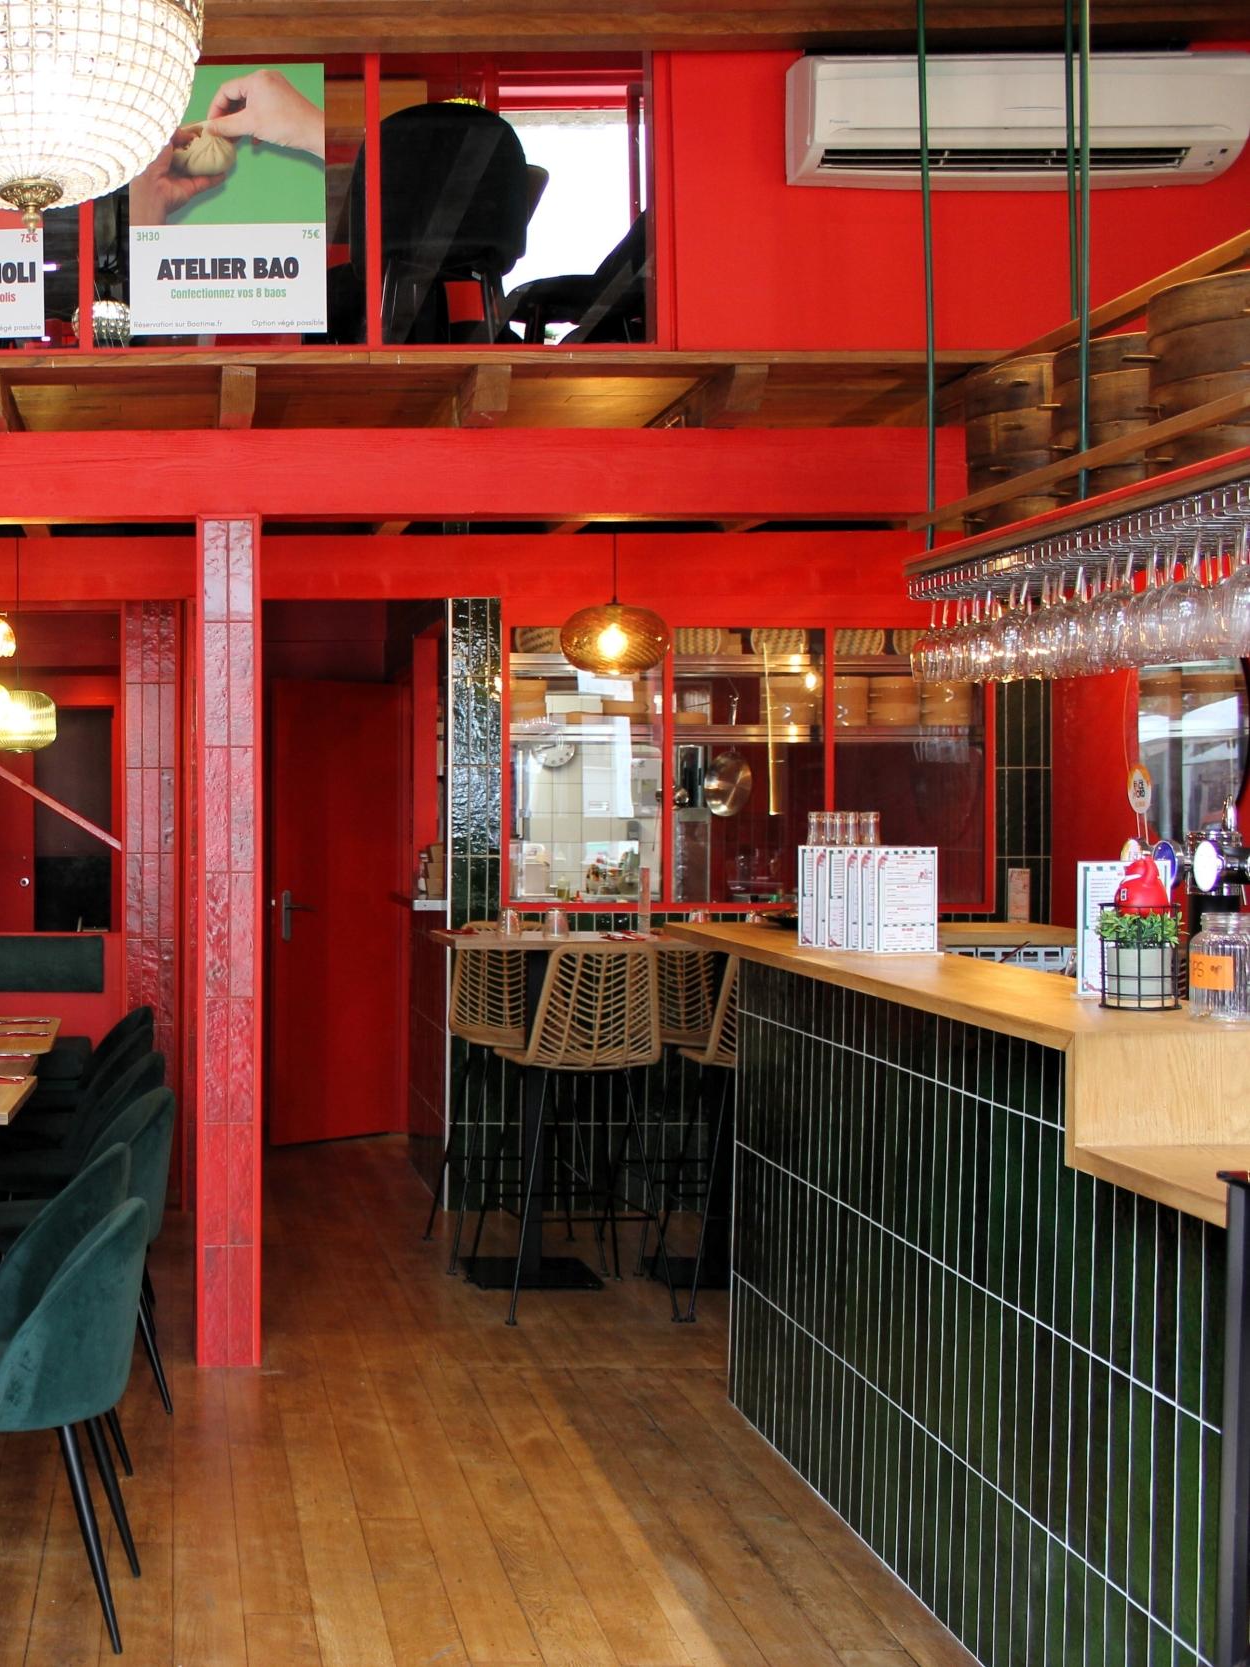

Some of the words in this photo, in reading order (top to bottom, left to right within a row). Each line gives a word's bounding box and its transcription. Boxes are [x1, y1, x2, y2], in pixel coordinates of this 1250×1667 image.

[20, 233, 38, 243] 75€
[136, 232, 160, 241] 3H30
[302, 229, 320, 239] 75€
[157, 258, 247, 280] ATELIER
[253, 256, 299, 279] BAO
[170, 288, 235, 300] Confectionnez
[237, 289, 254, 298] vos
[256, 287, 262, 298] 8
[264, 287, 287, 298] baos
[252, 319, 276, 327] Option
